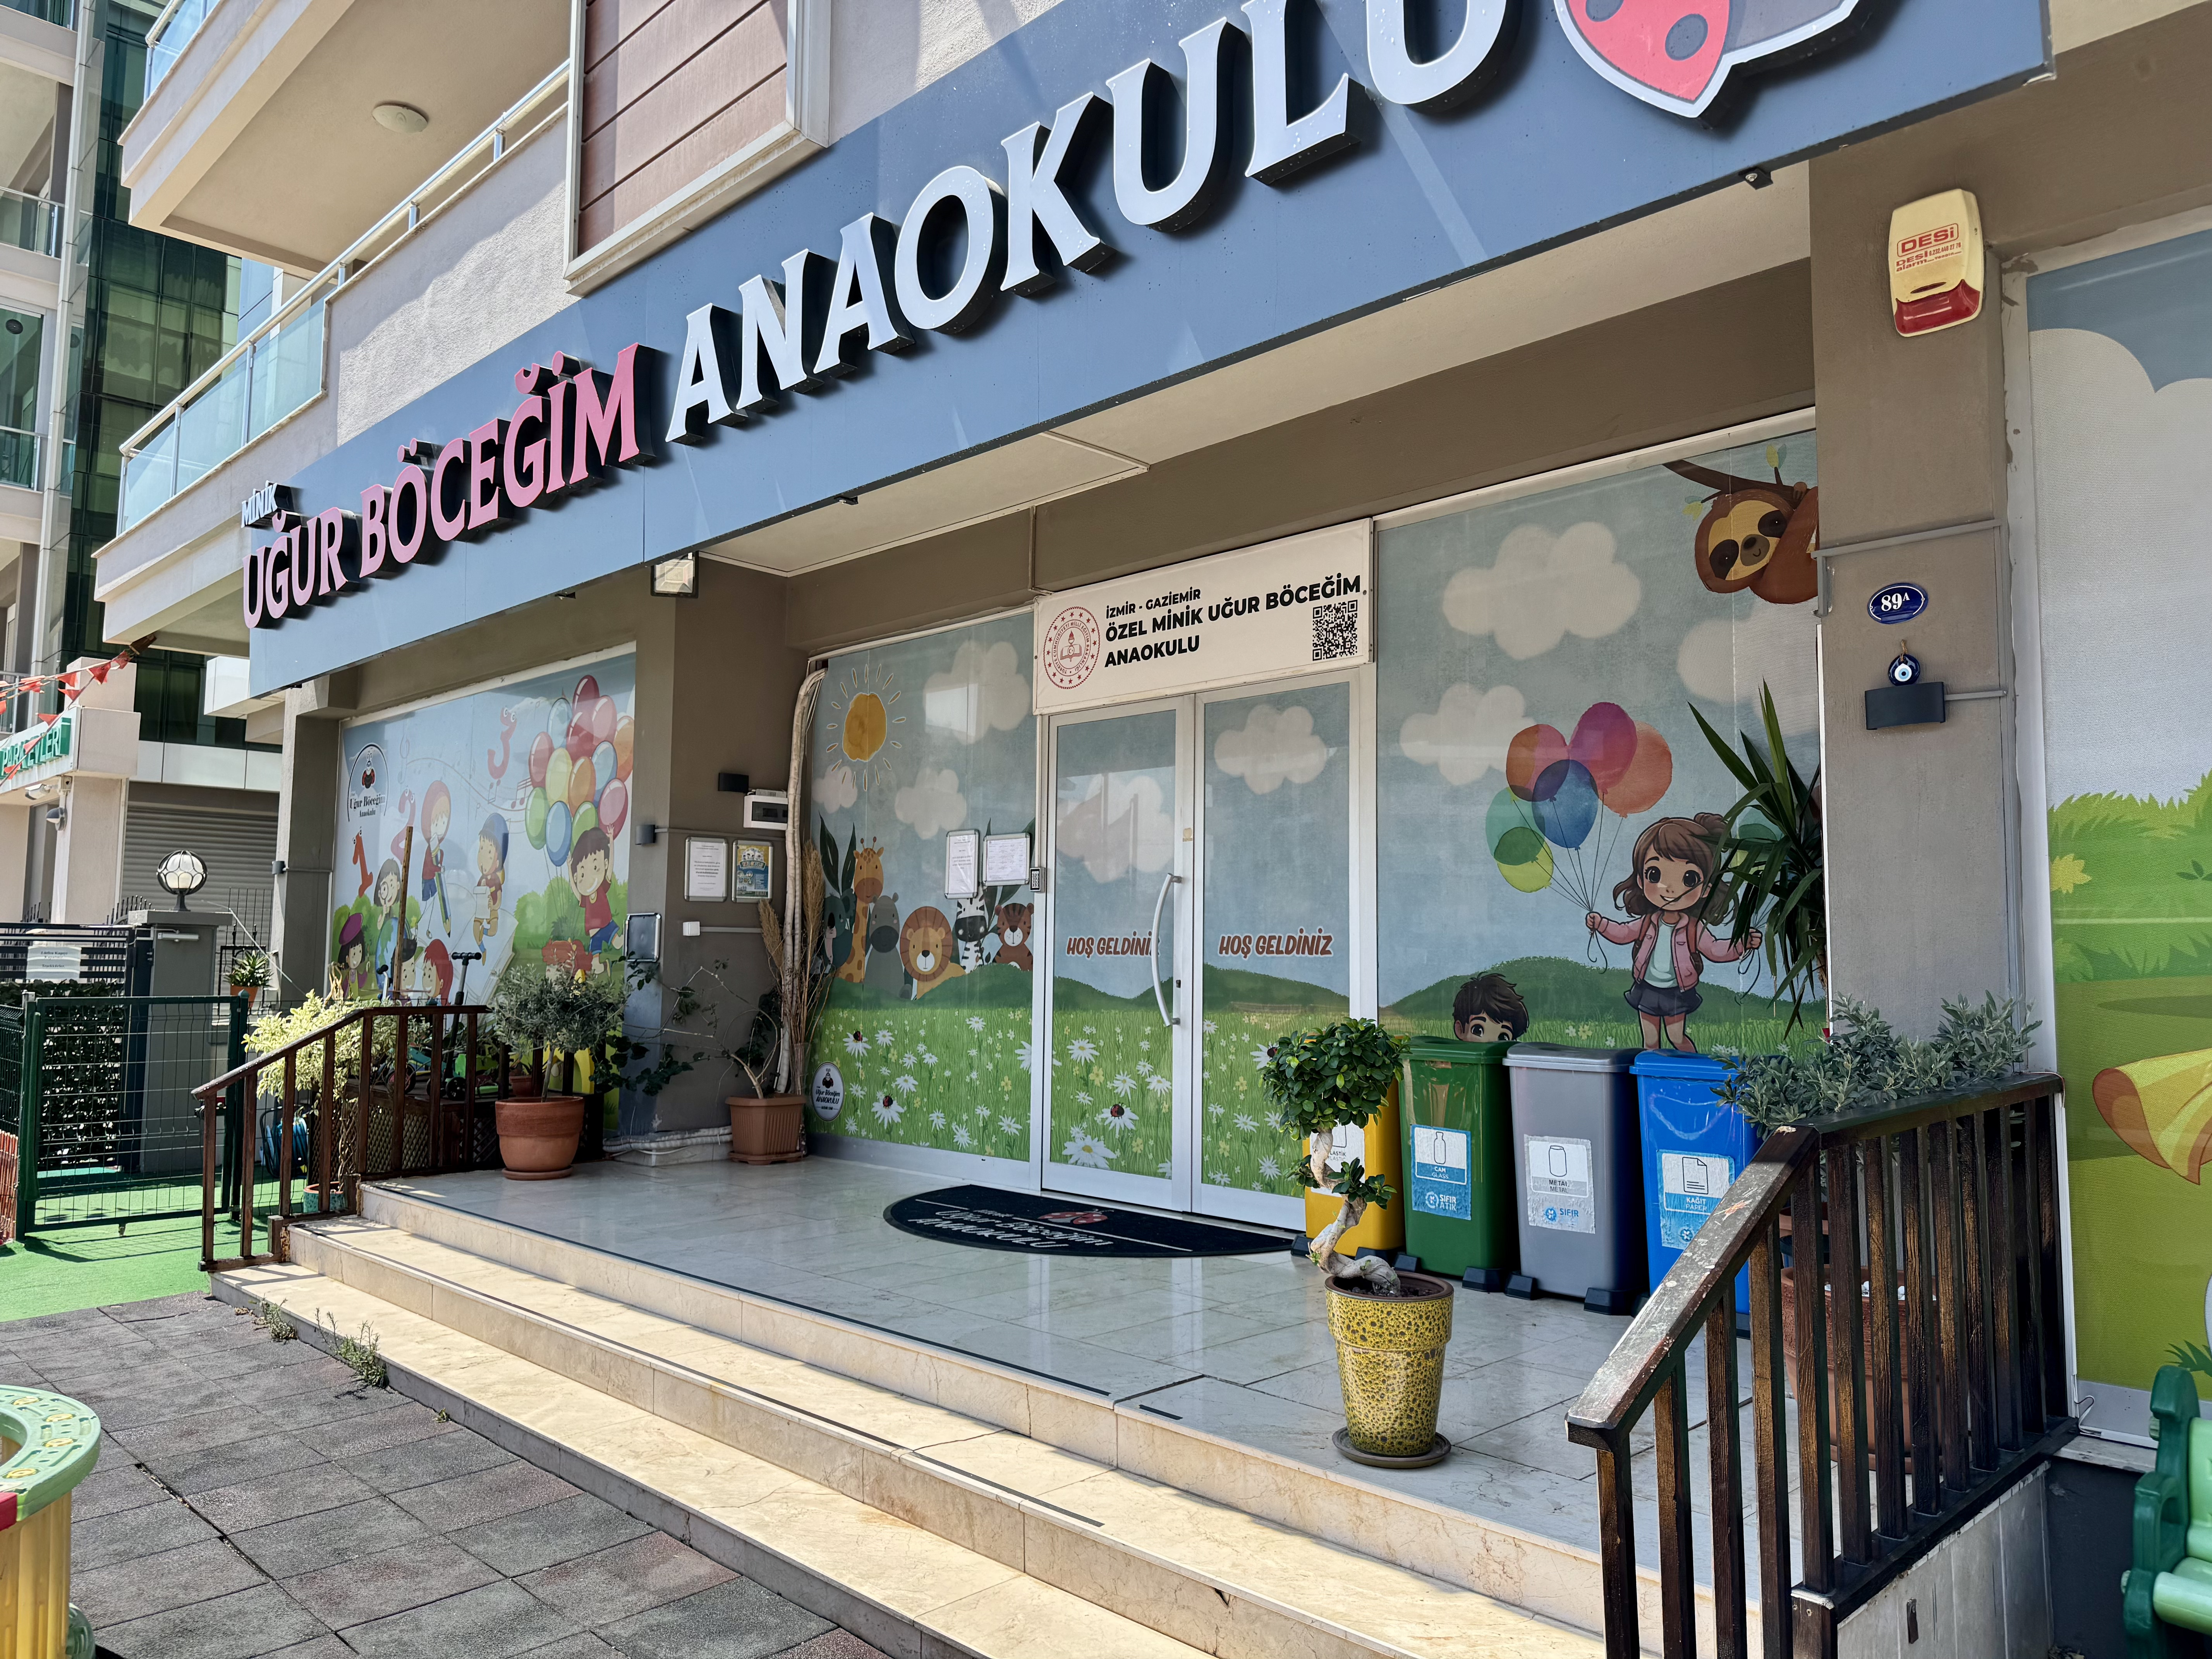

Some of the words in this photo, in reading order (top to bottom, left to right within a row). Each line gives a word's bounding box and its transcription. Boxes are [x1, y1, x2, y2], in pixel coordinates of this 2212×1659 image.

[1896, 259, 1927, 272] alarm
[242, 510, 348, 629] UĞUR
[359, 343, 639, 578] BÖCEĞİM
[241, 480, 278, 528] MİNİK
[1106, 601, 1135, 618] İZMİR
[1146, 586, 1200, 610] GAZİEMİR
[1106, 620, 1147, 641] ÖZEL
[1152, 605, 1203, 633] MİNİK
[1208, 596, 1259, 621] UĞUR
[1266, 573, 1360, 610] BÖCEĞİM
[1104, 635, 1199, 667] ANAOKULU
[1067, 937, 1094, 958] HOŞ
[1097, 931, 1159, 956] GELDİNİ
[1219, 936, 1252, 958] HOŞ
[1255, 928, 1333, 955] GELDİNİZ
[1439, 1194, 1456, 1204] SIFIR
[1439, 1201, 1457, 1212] ATIK
[1560, 1208, 1579, 1217] SIFIR
[907, 1219, 1069, 1248] ANAOKULU
